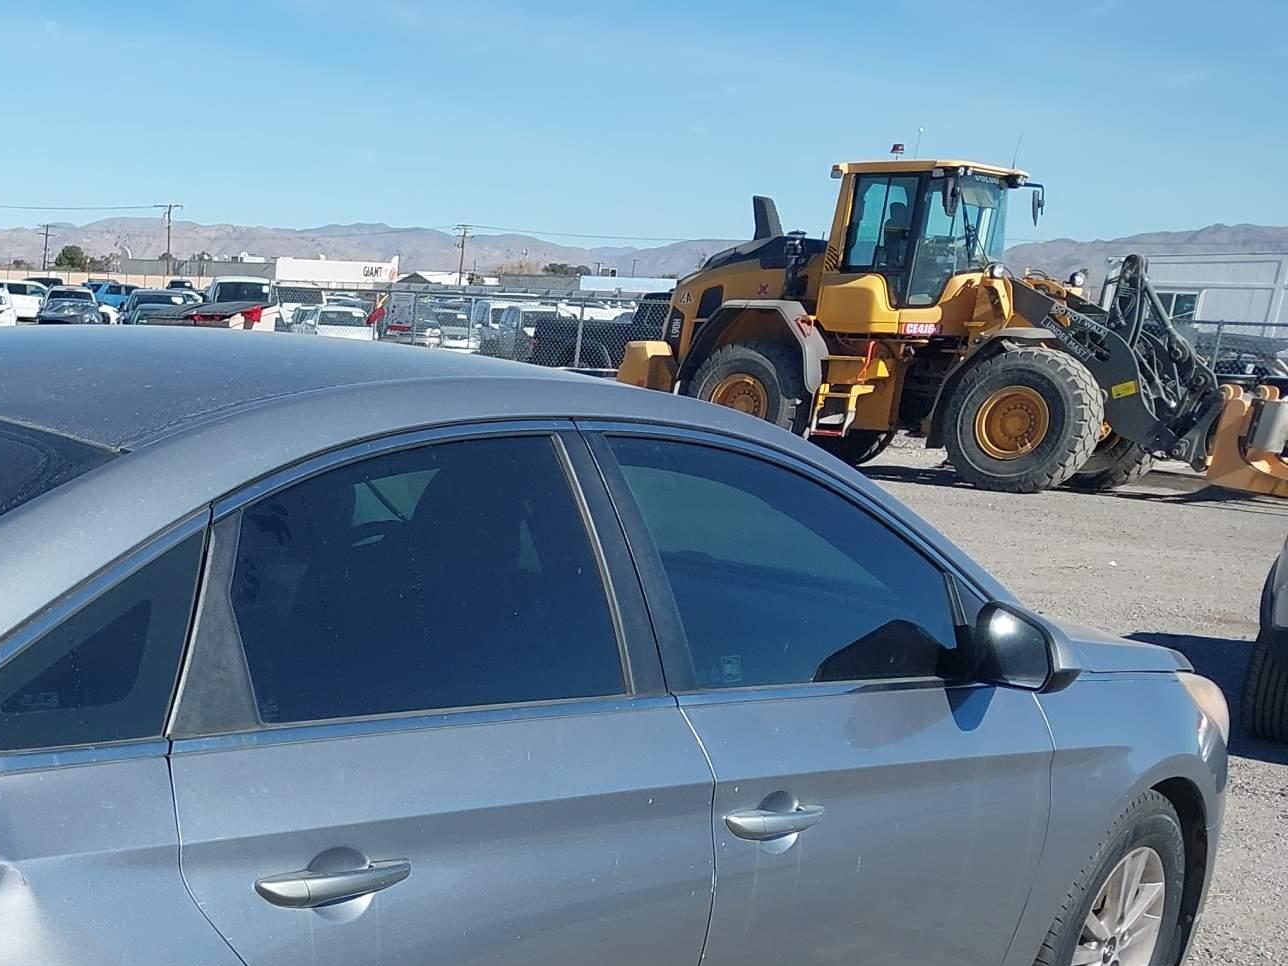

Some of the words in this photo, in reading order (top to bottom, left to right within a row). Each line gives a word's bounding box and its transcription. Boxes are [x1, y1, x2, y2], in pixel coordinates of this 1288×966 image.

[362, 265, 383, 278] GIANT
[670, 318, 682, 338] L90H
[1050, 302, 1066, 314] DO
[1066, 310, 1083, 324] NOT
[1083, 319, 1107, 337] WALK
[1045, 319, 1070, 341] UNDER
[1066, 339, 1087, 357] MAST
